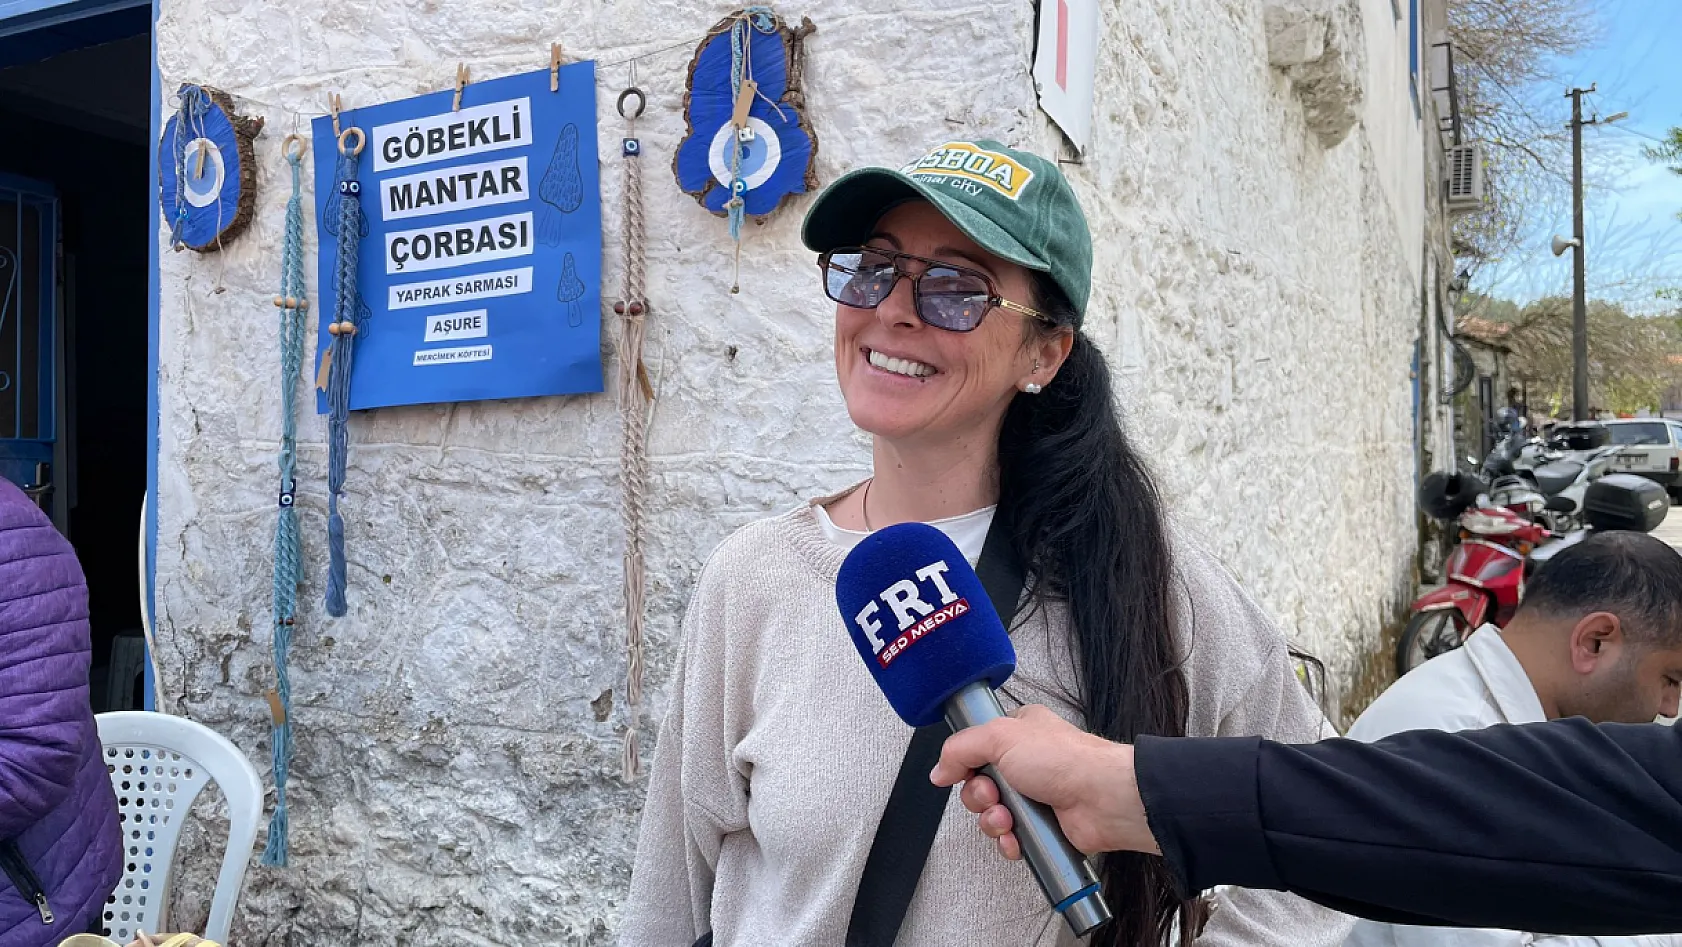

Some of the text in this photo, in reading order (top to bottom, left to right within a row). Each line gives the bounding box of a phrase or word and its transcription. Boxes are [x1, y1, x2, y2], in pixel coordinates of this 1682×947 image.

[382, 105, 522, 164] GÖBEKLİ
[388, 166, 523, 212] MANTAR
[917, 149, 1013, 190] SBOA
[951, 178, 983, 197] city
[390, 220, 529, 270] ÇORBASI
[396, 275, 519, 303] YAPRAK SARMASI
[432, 315, 482, 336] AŞURE
[854, 560, 959, 655] FRT
[882, 603, 968, 663] SED MEDYA
